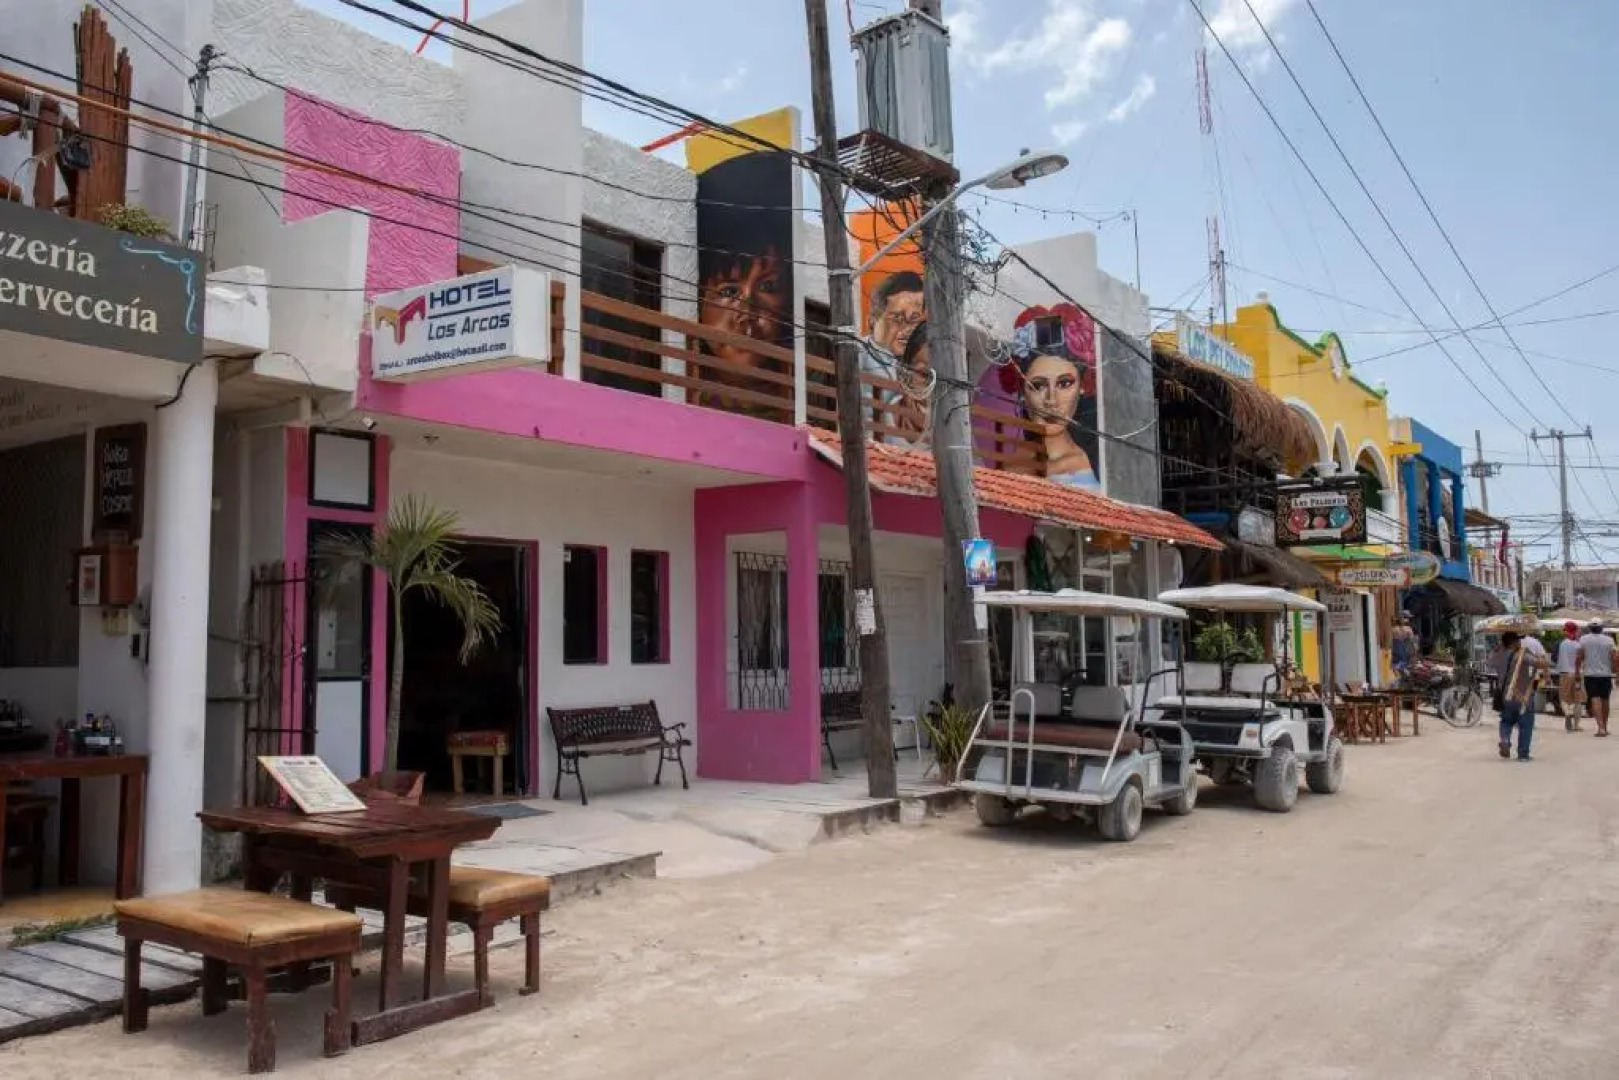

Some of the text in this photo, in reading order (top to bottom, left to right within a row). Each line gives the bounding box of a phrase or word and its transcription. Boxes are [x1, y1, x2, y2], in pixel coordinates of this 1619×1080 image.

[0, 231, 96, 277] zería
[0, 277, 158, 333] ervecería
[429, 278, 511, 309] HOTEL
[428, 313, 511, 341] Los Arcos
